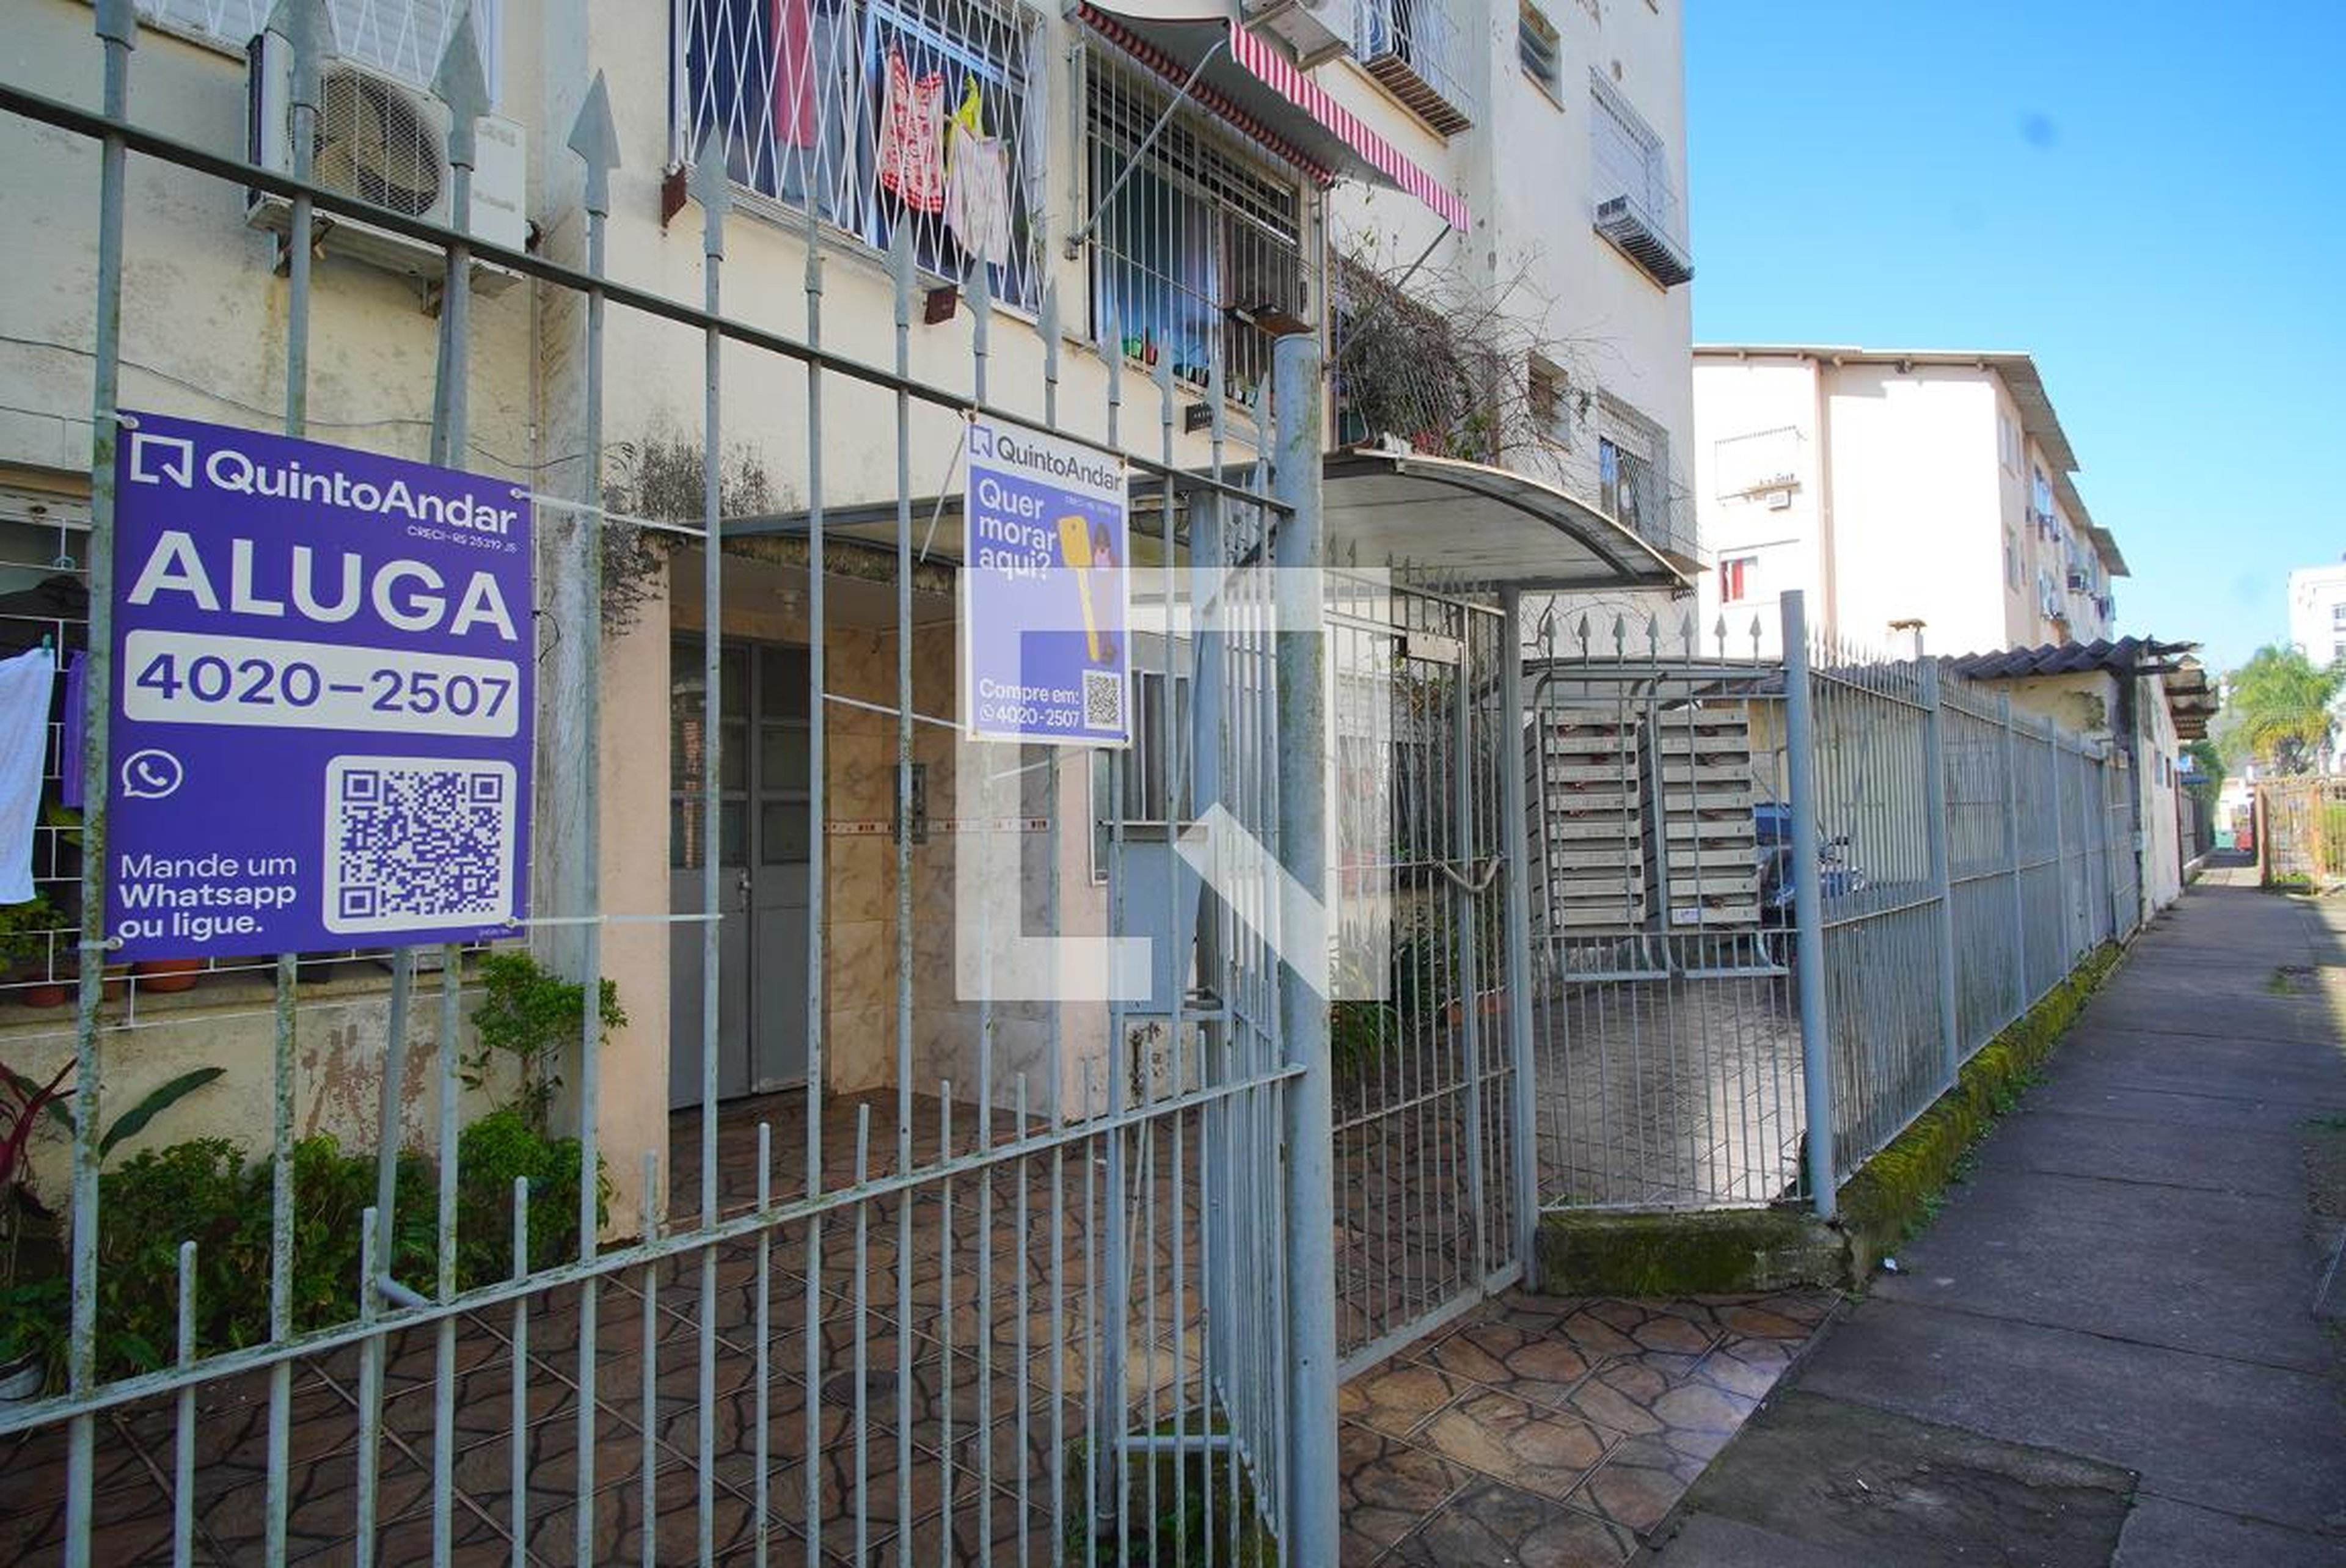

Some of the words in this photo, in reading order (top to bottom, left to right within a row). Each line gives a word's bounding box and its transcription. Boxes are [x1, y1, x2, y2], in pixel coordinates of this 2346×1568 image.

[997, 436, 1122, 491] QuintoAndar
[205, 450, 517, 534] QuintoAndar
[979, 477, 1045, 519] Quer
[979, 516, 1057, 552] morar
[979, 547, 1051, 580] aqui?
[126, 530, 518, 641] ALUGA
[135, 652, 512, 718] 4020-2507
[979, 677, 1049, 704] Compre
[1051, 688, 1080, 705] em:
[120, 853, 239, 879] Mande
[247, 855, 297, 877] um
[119, 883, 297, 910] Whatsapp
[118, 918, 164, 939] ou
[173, 912, 263, 941] ligue.
